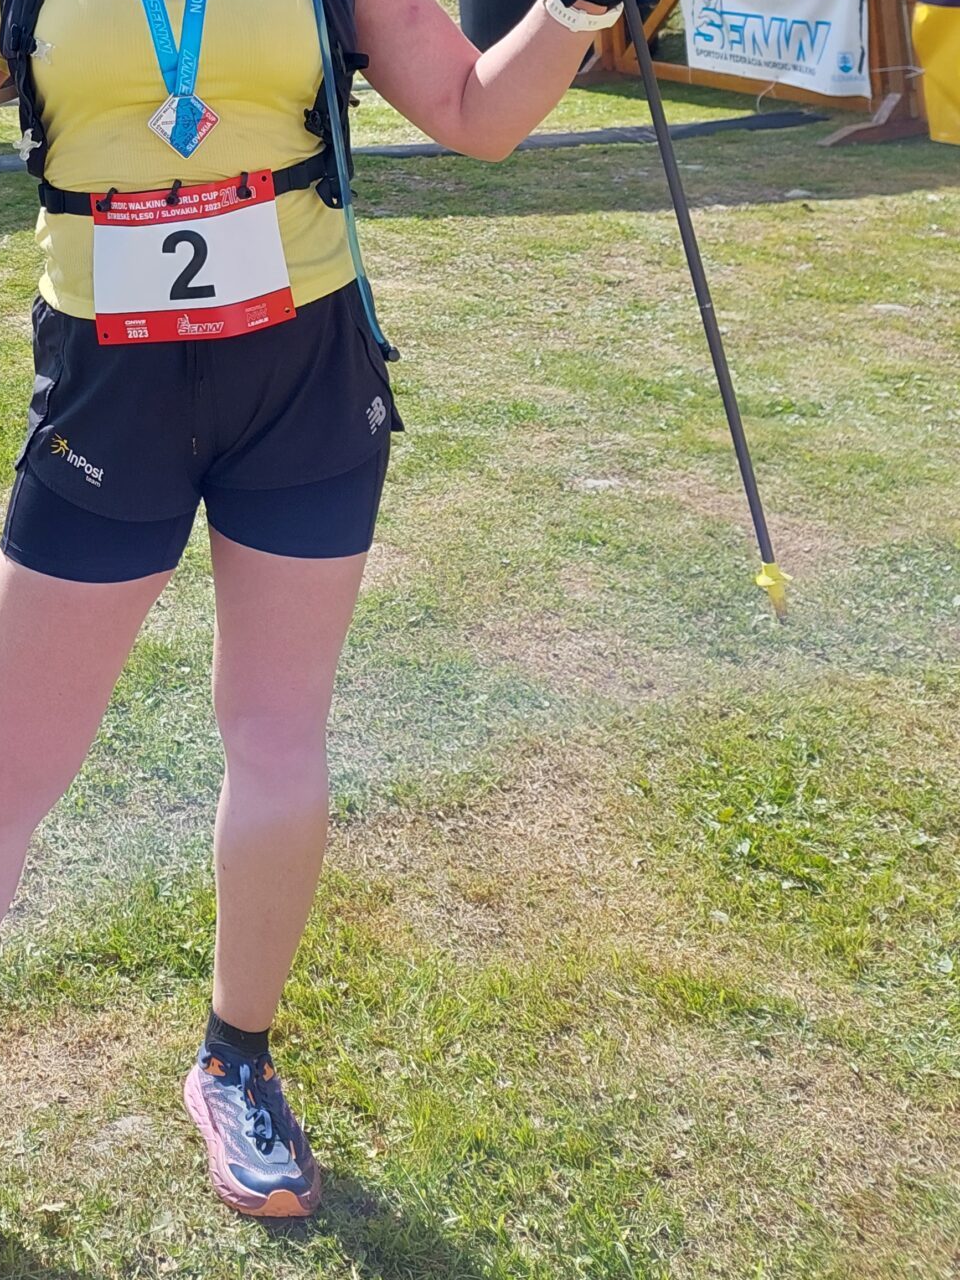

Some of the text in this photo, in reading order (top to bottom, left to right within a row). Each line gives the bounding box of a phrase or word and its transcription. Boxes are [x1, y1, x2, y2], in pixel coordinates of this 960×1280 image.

[186, 121, 213, 152] SLOVAKIA
[110, 201, 128, 210] ORDIC
[128, 199, 167, 210] WALKING
[178, 194, 200, 205] ORLD
[201, 191, 219, 202] CUP
[131, 211, 155, 221] PLESO
[161, 206, 198, 218] SLOVAKIA
[204, 201, 222, 212] 2023
[161, 229, 217, 301] 2
[127, 330, 149, 339] 2023
[66, 449, 105, 482] InPost
